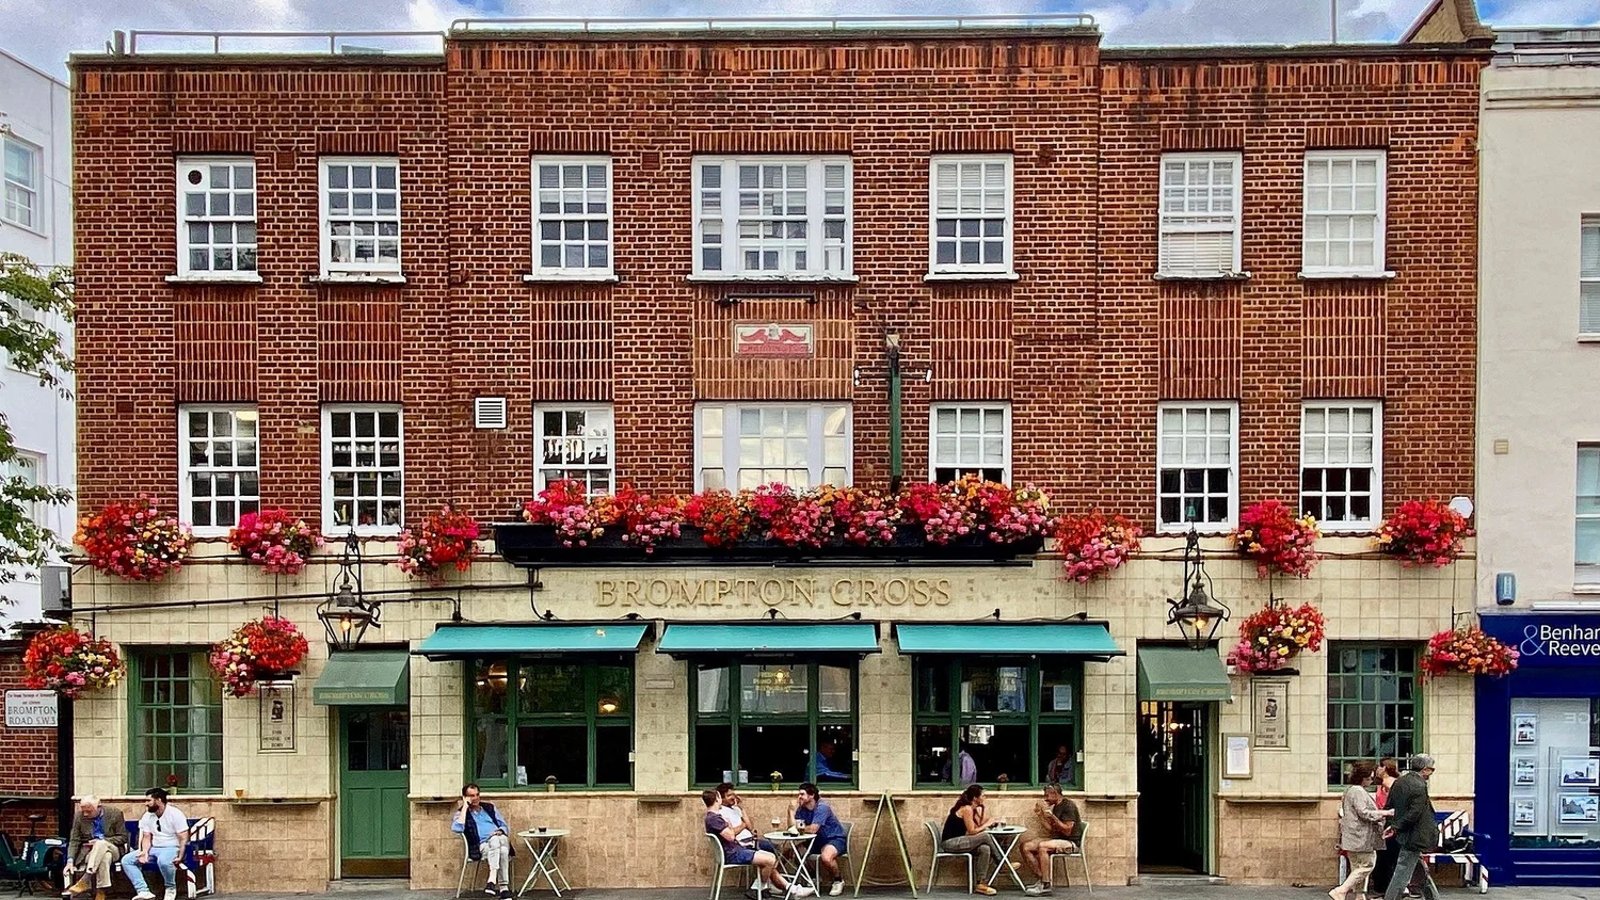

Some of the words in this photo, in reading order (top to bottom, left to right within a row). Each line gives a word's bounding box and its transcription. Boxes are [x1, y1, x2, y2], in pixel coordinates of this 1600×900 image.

[596, 579, 817, 607] BROMPTON
[831, 578, 951, 606] CROSS
[1520, 624, 1546, 656] &
[7, 705, 57, 715] BROMPTON
[9, 716, 34, 725] ROAD
